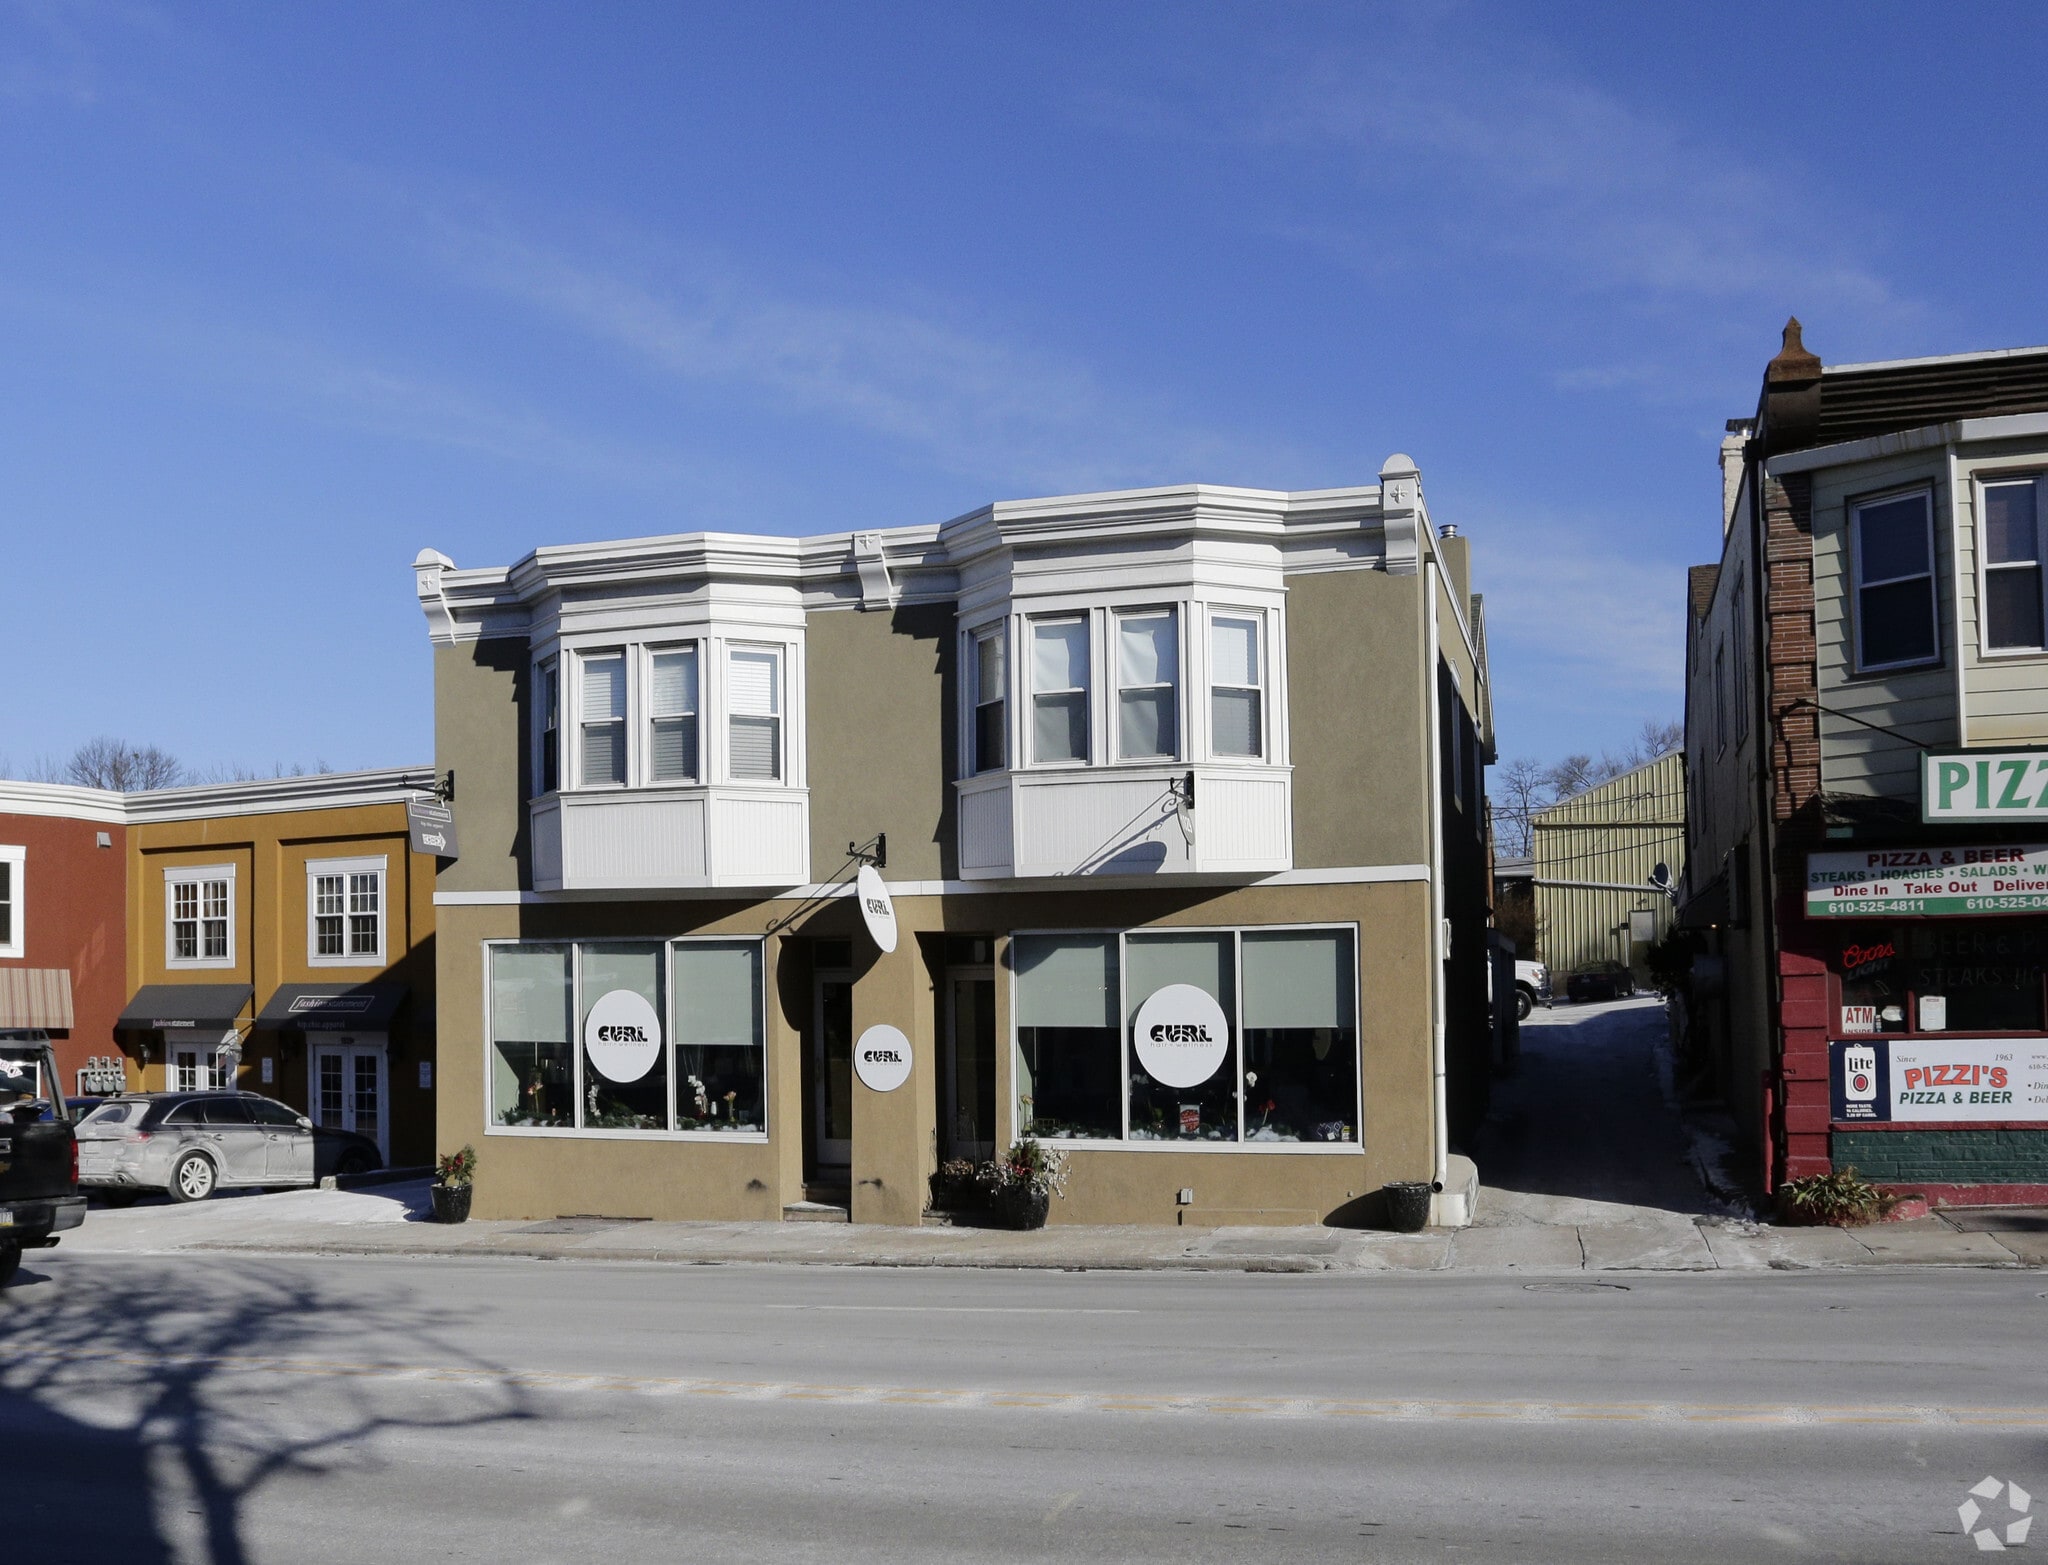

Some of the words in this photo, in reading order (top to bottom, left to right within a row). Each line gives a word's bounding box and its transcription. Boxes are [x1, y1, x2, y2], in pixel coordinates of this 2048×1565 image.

[1867, 852, 1933, 868] PIZZA
[1940, 850, 1955, 865] &
[1964, 848, 2025, 864] BEER
[1811, 871, 1866, 883] STEAKS
[1880, 868, 1945, 880] HOAGIES
[1960, 865, 2018, 878] SALADS
[2033, 864, 2048, 875] W
[1834, 885, 1868, 897] Dine
[1874, 884, 1888, 896] In
[1903, 882, 1943, 895] Take
[1948, 880, 1978, 893] Out
[866, 897, 890, 916] CURL
[1828, 899, 1924, 913] 610-525-4811
[1842, 942, 1896, 969] Coors
[1845, 1007, 1873, 1024] ATM
[598, 1025, 648, 1043] CURL
[1150, 1024, 1213, 1043] CURL
[864, 1050, 902, 1063] CURL
[1848, 1057, 1873, 1073] Lite
[1896, 1055, 1917, 1063] Since
[1994, 1053, 2013, 1062] 1963
[1904, 1064, 2008, 1090] PIZZI'S
[1899, 1091, 1946, 1105] PIZZA
[1953, 1091, 1963, 1105] &
[1969, 1091, 2013, 1105] BEER
